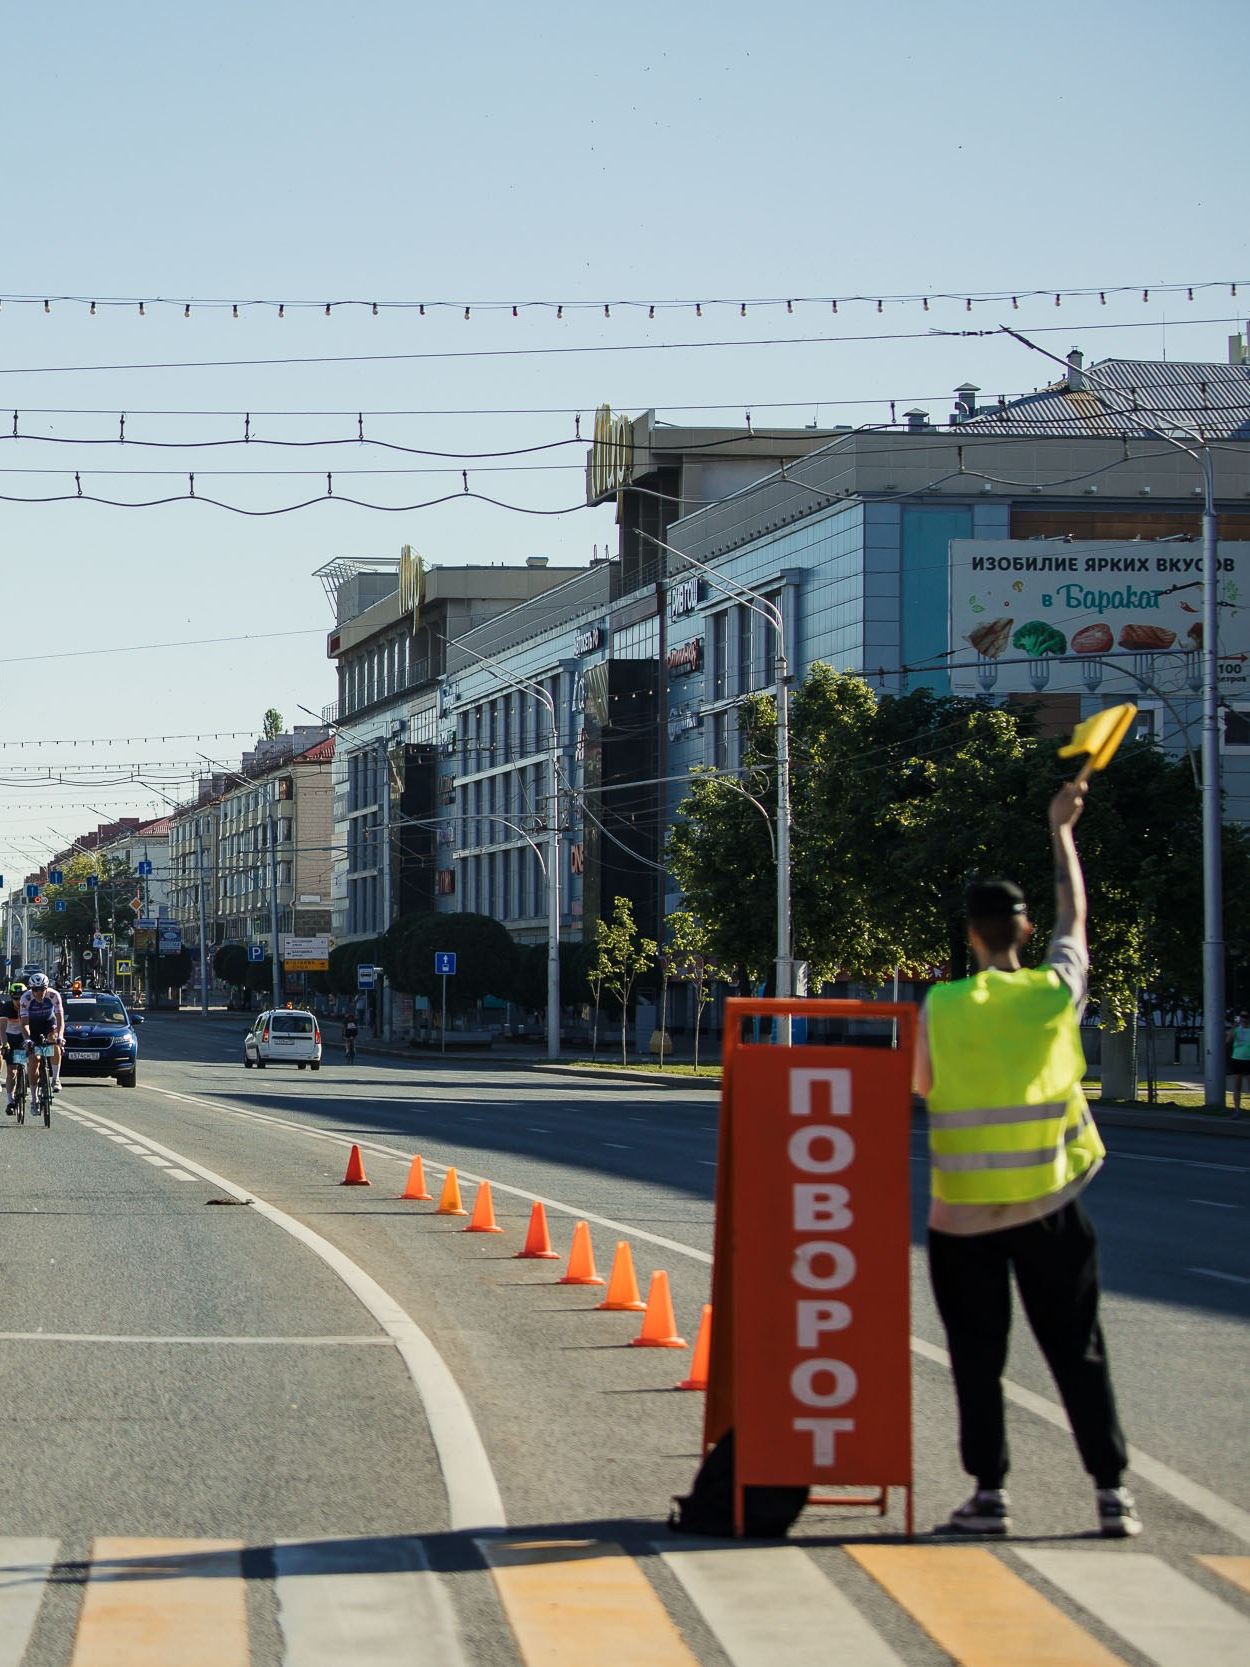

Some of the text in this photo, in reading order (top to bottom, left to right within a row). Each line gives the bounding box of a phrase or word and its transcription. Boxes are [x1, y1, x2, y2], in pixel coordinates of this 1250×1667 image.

[972, 557, 1078, 571] ИЗОБИЛИЕ
[1085, 557, 1149, 572] ЯРКИХ
[1042, 584, 1163, 614] в Баракат
[1219, 664, 1242, 674] 100
[252, 946, 261, 960] P
[788, 1067, 858, 1467] ПОВОРОТ
